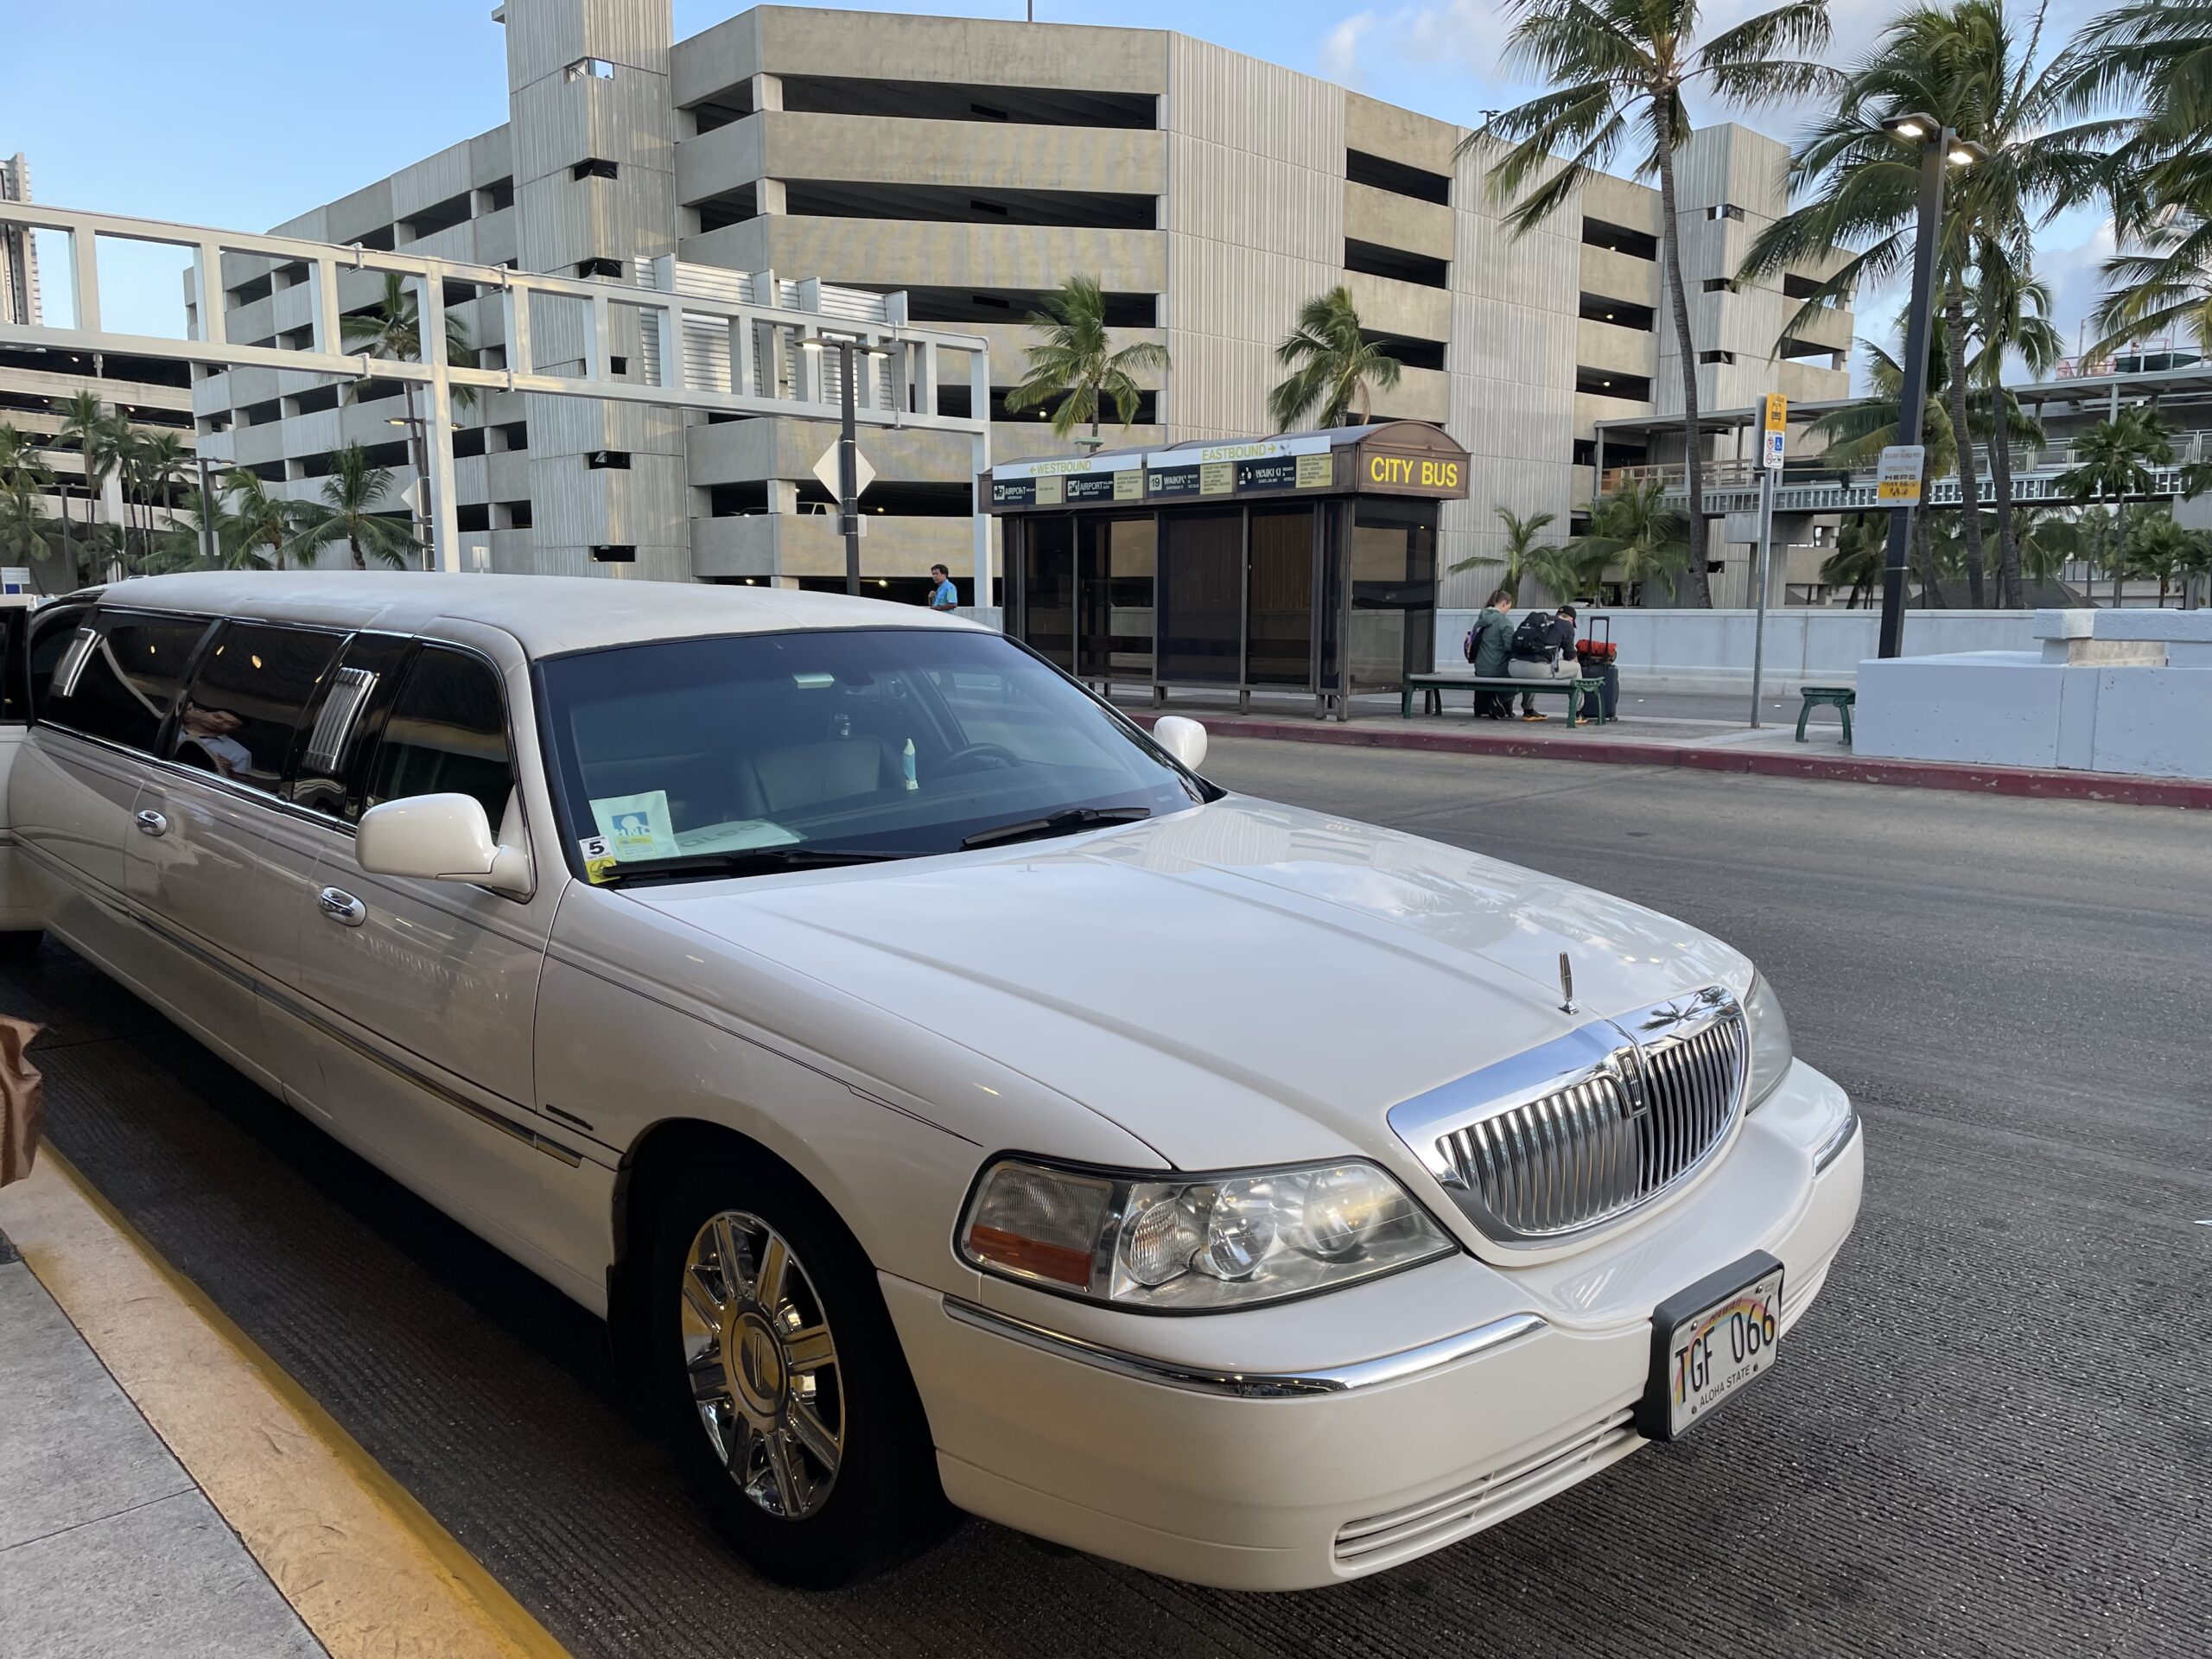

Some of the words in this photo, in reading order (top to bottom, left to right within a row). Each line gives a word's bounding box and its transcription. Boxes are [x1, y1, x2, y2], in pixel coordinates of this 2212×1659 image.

[1202, 443, 1267, 461] EASTBOUND
[1037, 460, 1091, 474] WESTBOUND
[1370, 456, 1414, 484] CITY
[1421, 461, 1458, 487] BUS
[1080, 481, 1103, 492] AIRPORT
[1151, 477, 1160, 488] 19
[589, 840, 605, 855] 5
[1675, 1325, 1715, 1403] TGF
[1731, 1294, 1775, 1363] 066
[1700, 1384, 1725, 1408] ALOHA
[1726, 1365, 1751, 1389] STATE
